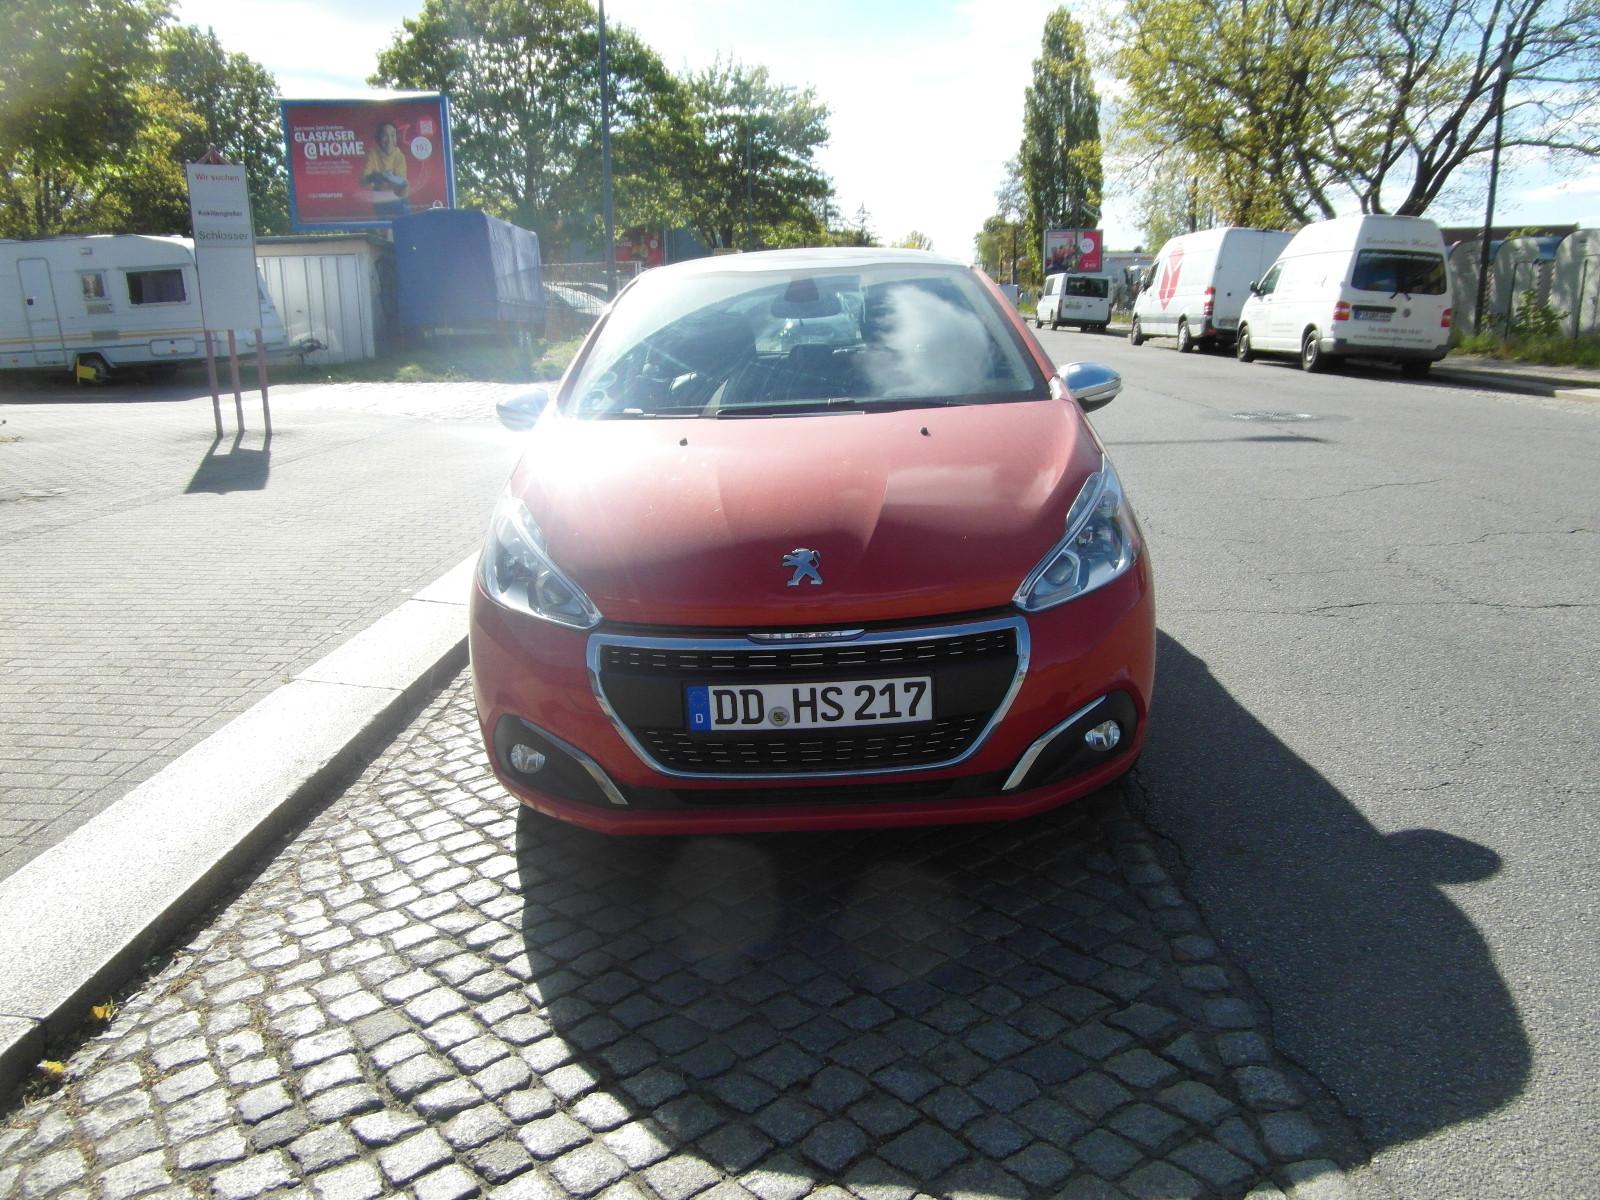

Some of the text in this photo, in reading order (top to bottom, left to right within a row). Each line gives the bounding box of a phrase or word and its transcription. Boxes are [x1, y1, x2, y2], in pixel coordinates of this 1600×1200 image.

[294, 130, 355, 142] GLASFASER
[195, 172, 239, 182] Wir suchen
[198, 230, 249, 241] Schlosser
[712, 681, 928, 725] DD HS 217
[695, 713, 704, 724] D
